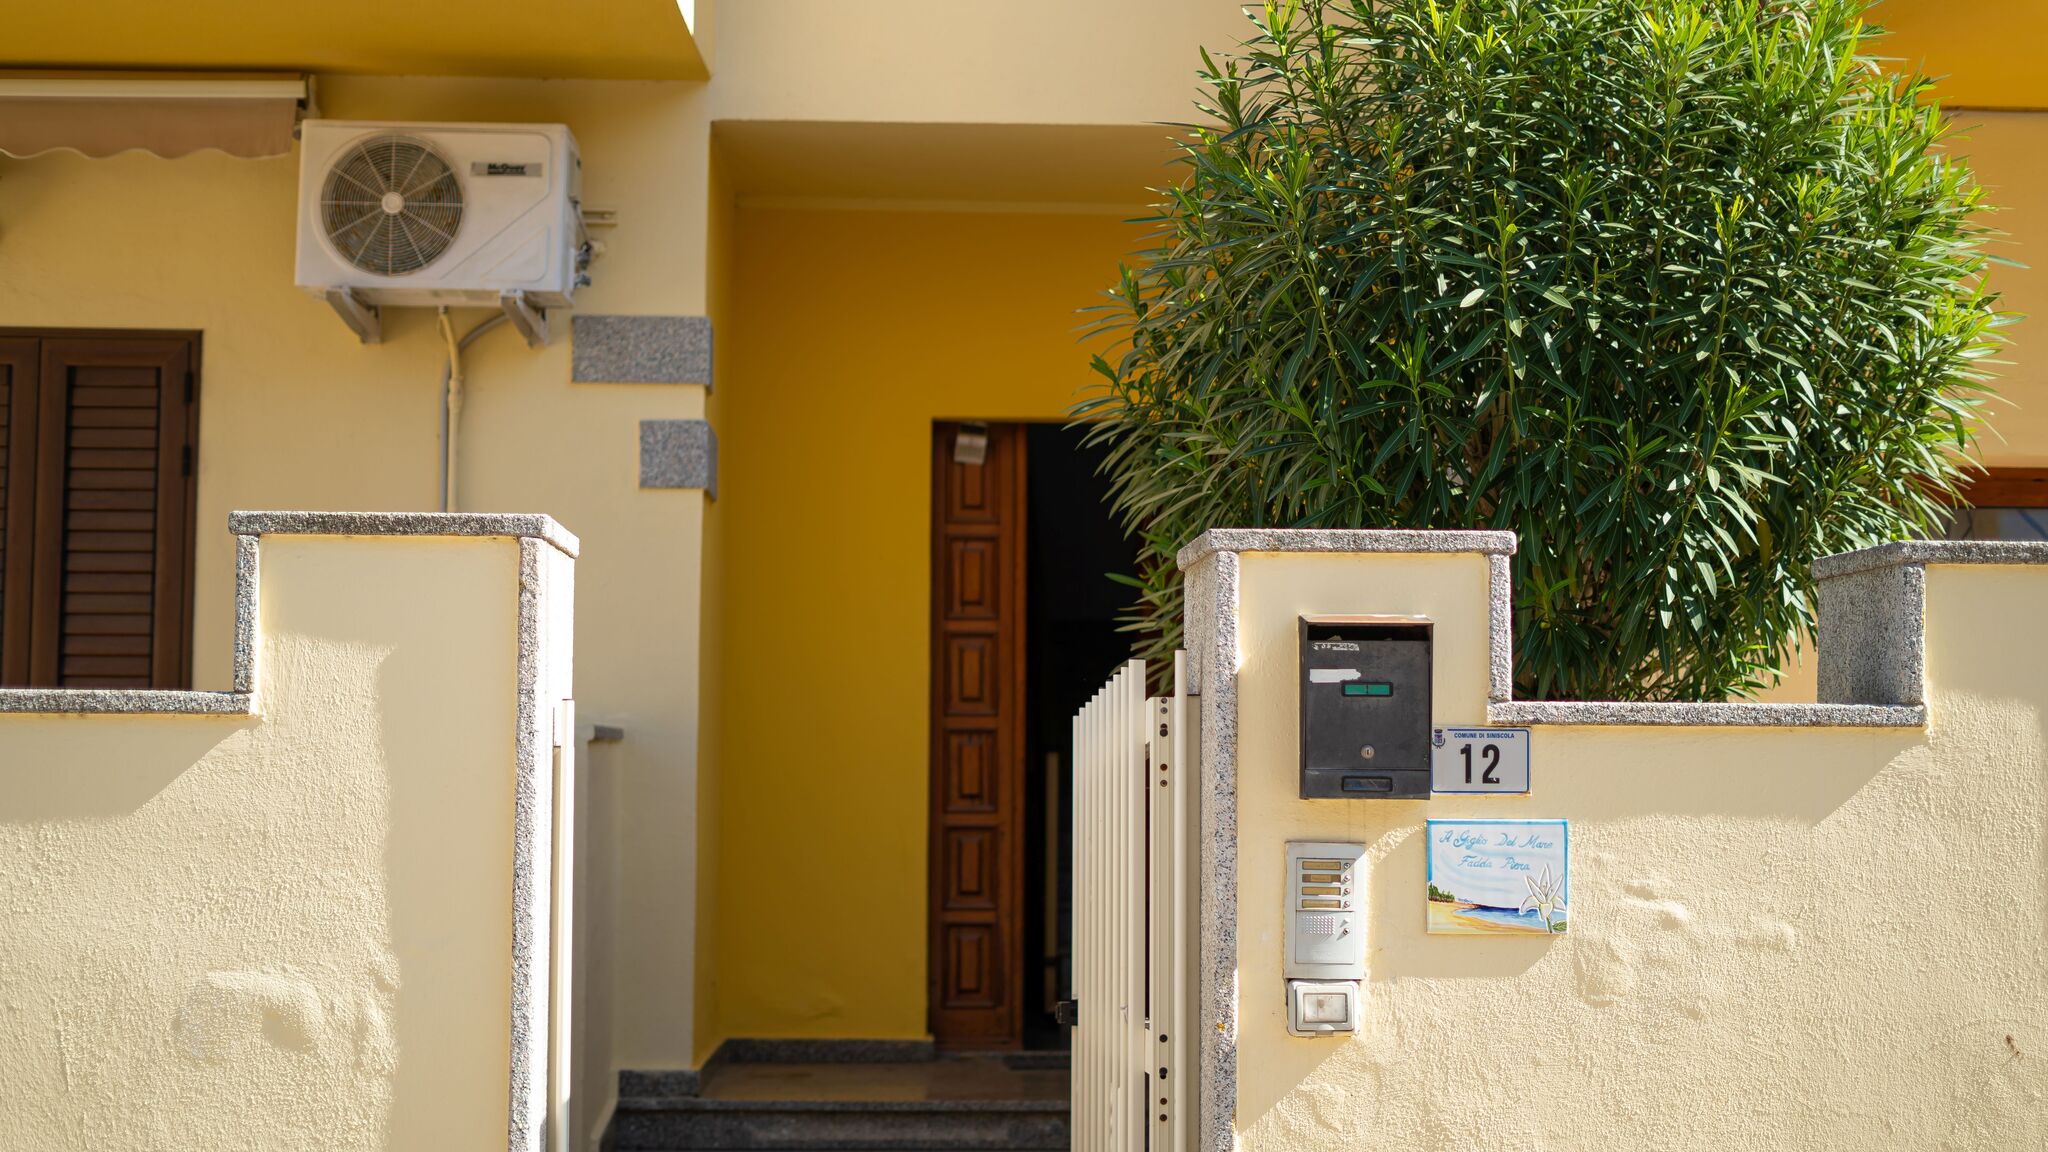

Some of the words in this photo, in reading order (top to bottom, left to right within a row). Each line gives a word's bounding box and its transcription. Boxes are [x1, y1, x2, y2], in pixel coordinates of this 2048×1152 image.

[1460, 743, 1500, 784] 12
[1494, 832, 1518, 847] Del
[1519, 834, 1553, 849] Mare
[1458, 855, 1493, 868] Fadda
